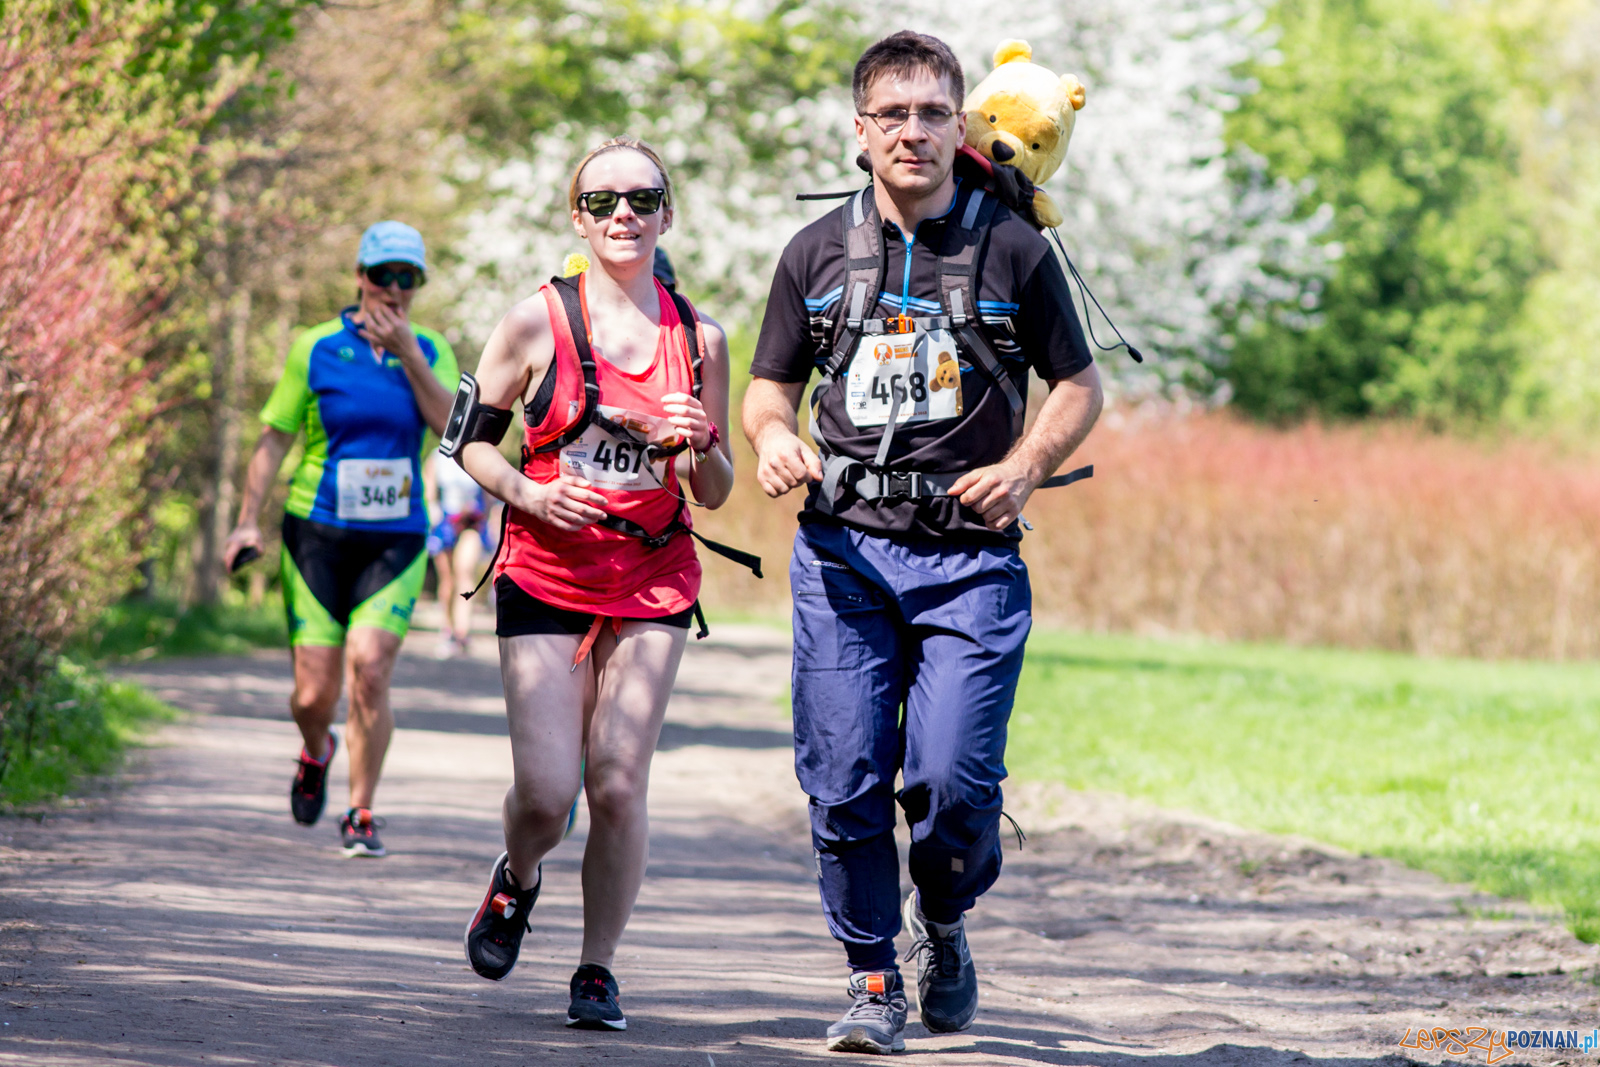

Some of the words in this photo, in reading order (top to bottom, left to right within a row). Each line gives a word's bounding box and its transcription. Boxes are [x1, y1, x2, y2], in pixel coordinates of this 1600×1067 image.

[871, 372, 927, 406] 468
[593, 440, 645, 474] 467
[361, 486, 397, 507] 348
